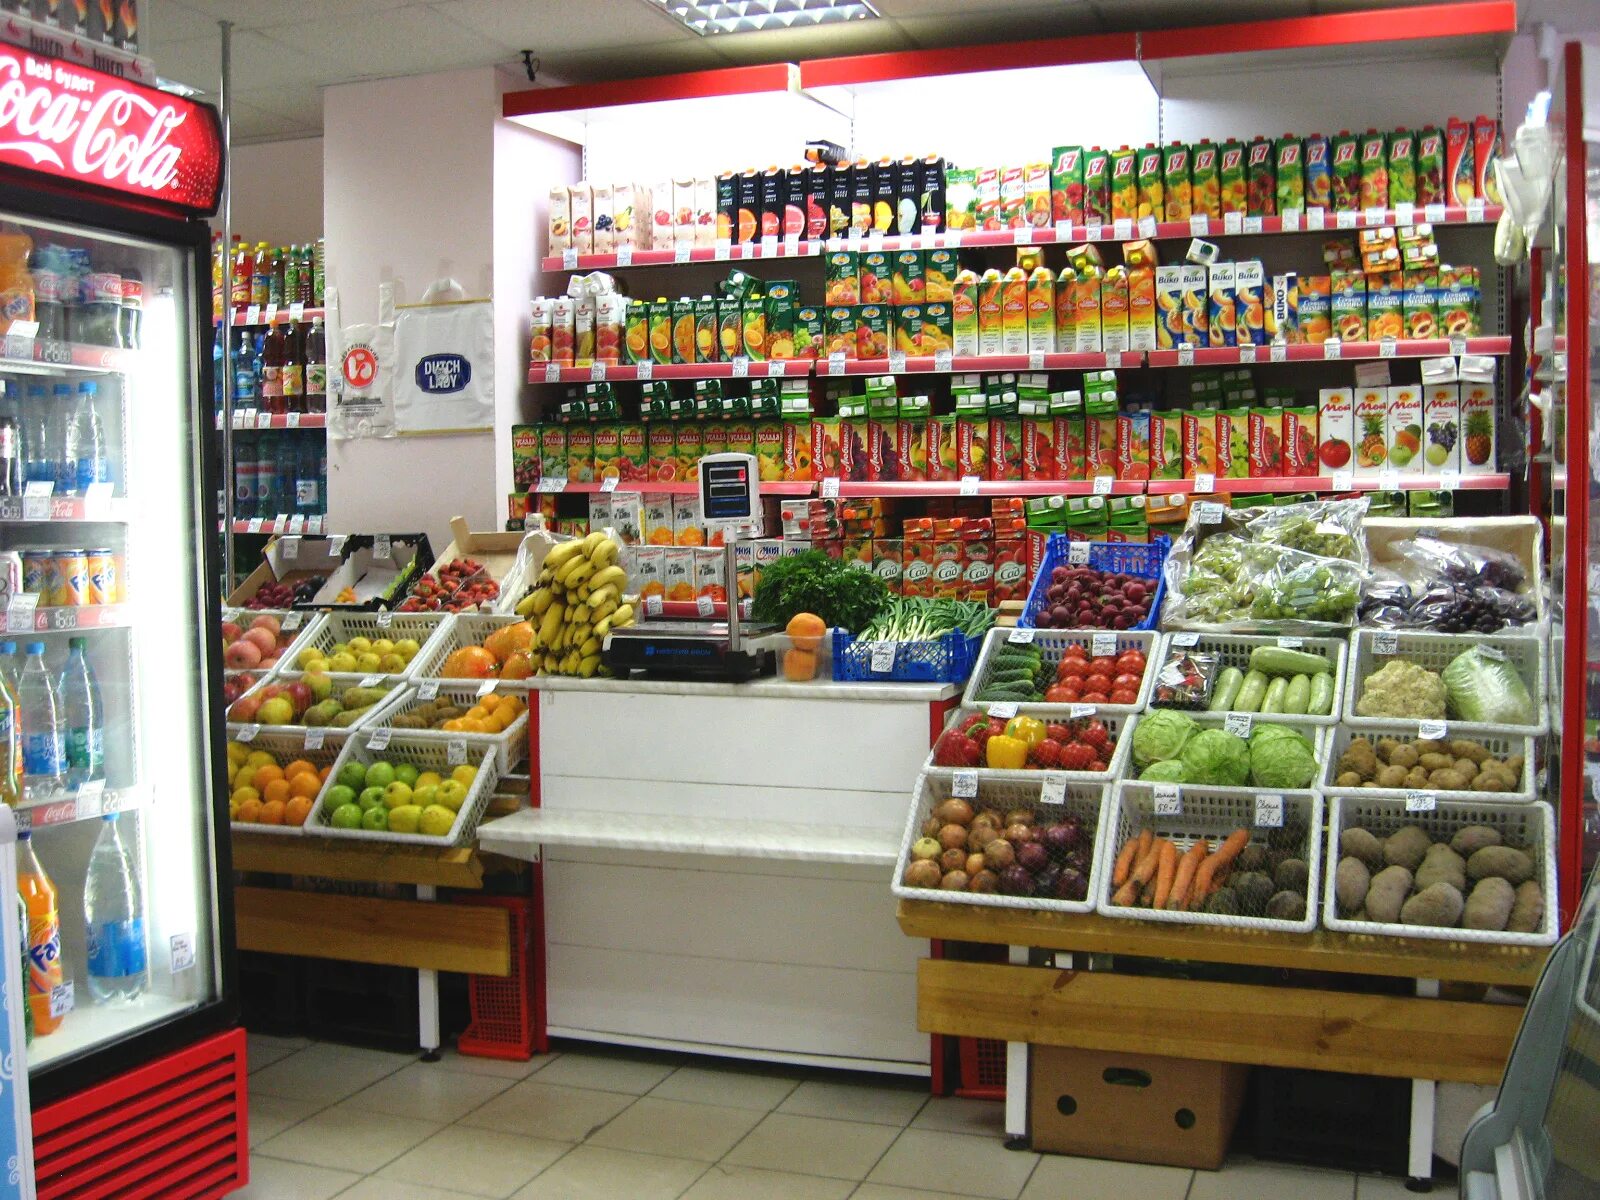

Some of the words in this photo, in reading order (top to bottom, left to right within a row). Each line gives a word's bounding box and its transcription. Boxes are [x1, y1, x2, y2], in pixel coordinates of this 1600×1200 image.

[424, 360, 461, 375] DUTCH
[429, 375, 458, 389] LADY
[878, 563, 898, 579] Сад
[909, 562, 929, 578] Сад
[938, 562, 958, 578] Сад
[968, 563, 988, 579] Сад
[1000, 563, 1020, 578] Сад
